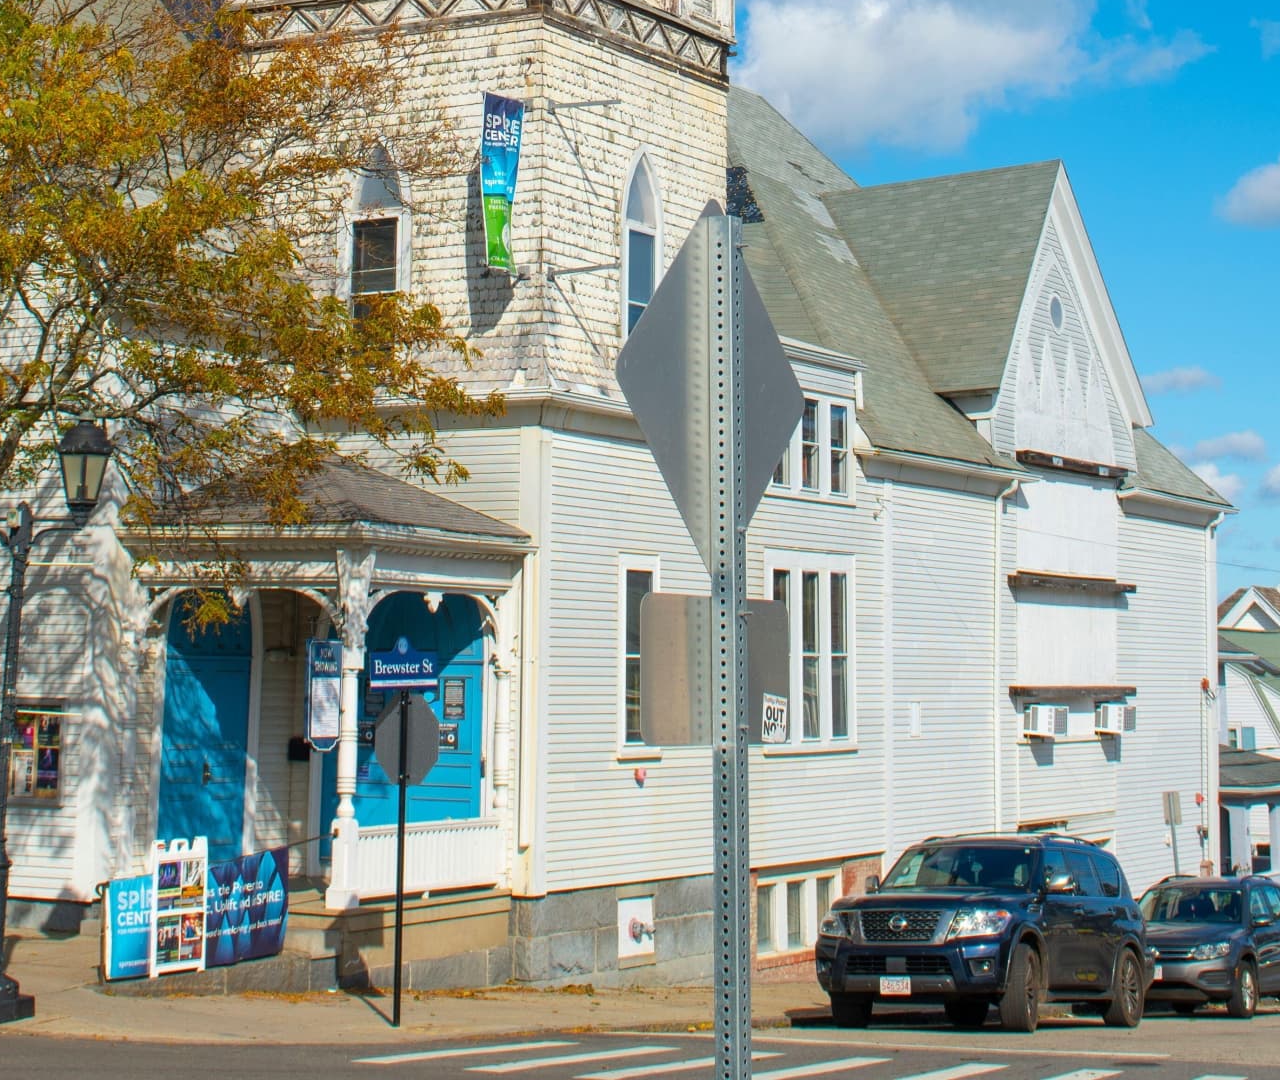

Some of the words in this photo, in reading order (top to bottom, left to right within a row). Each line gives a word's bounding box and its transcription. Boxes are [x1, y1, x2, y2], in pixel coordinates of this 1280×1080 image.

[486, 111, 521, 135] SPIRE
[484, 129, 519, 147] CENER
[374, 659, 420, 675] Brewster
[422, 658, 433, 673] St
[765, 705, 785, 723] OUT
[763, 720, 785, 736] NO
[117, 881, 153, 910] SPIR
[117, 910, 152, 927] CENT
